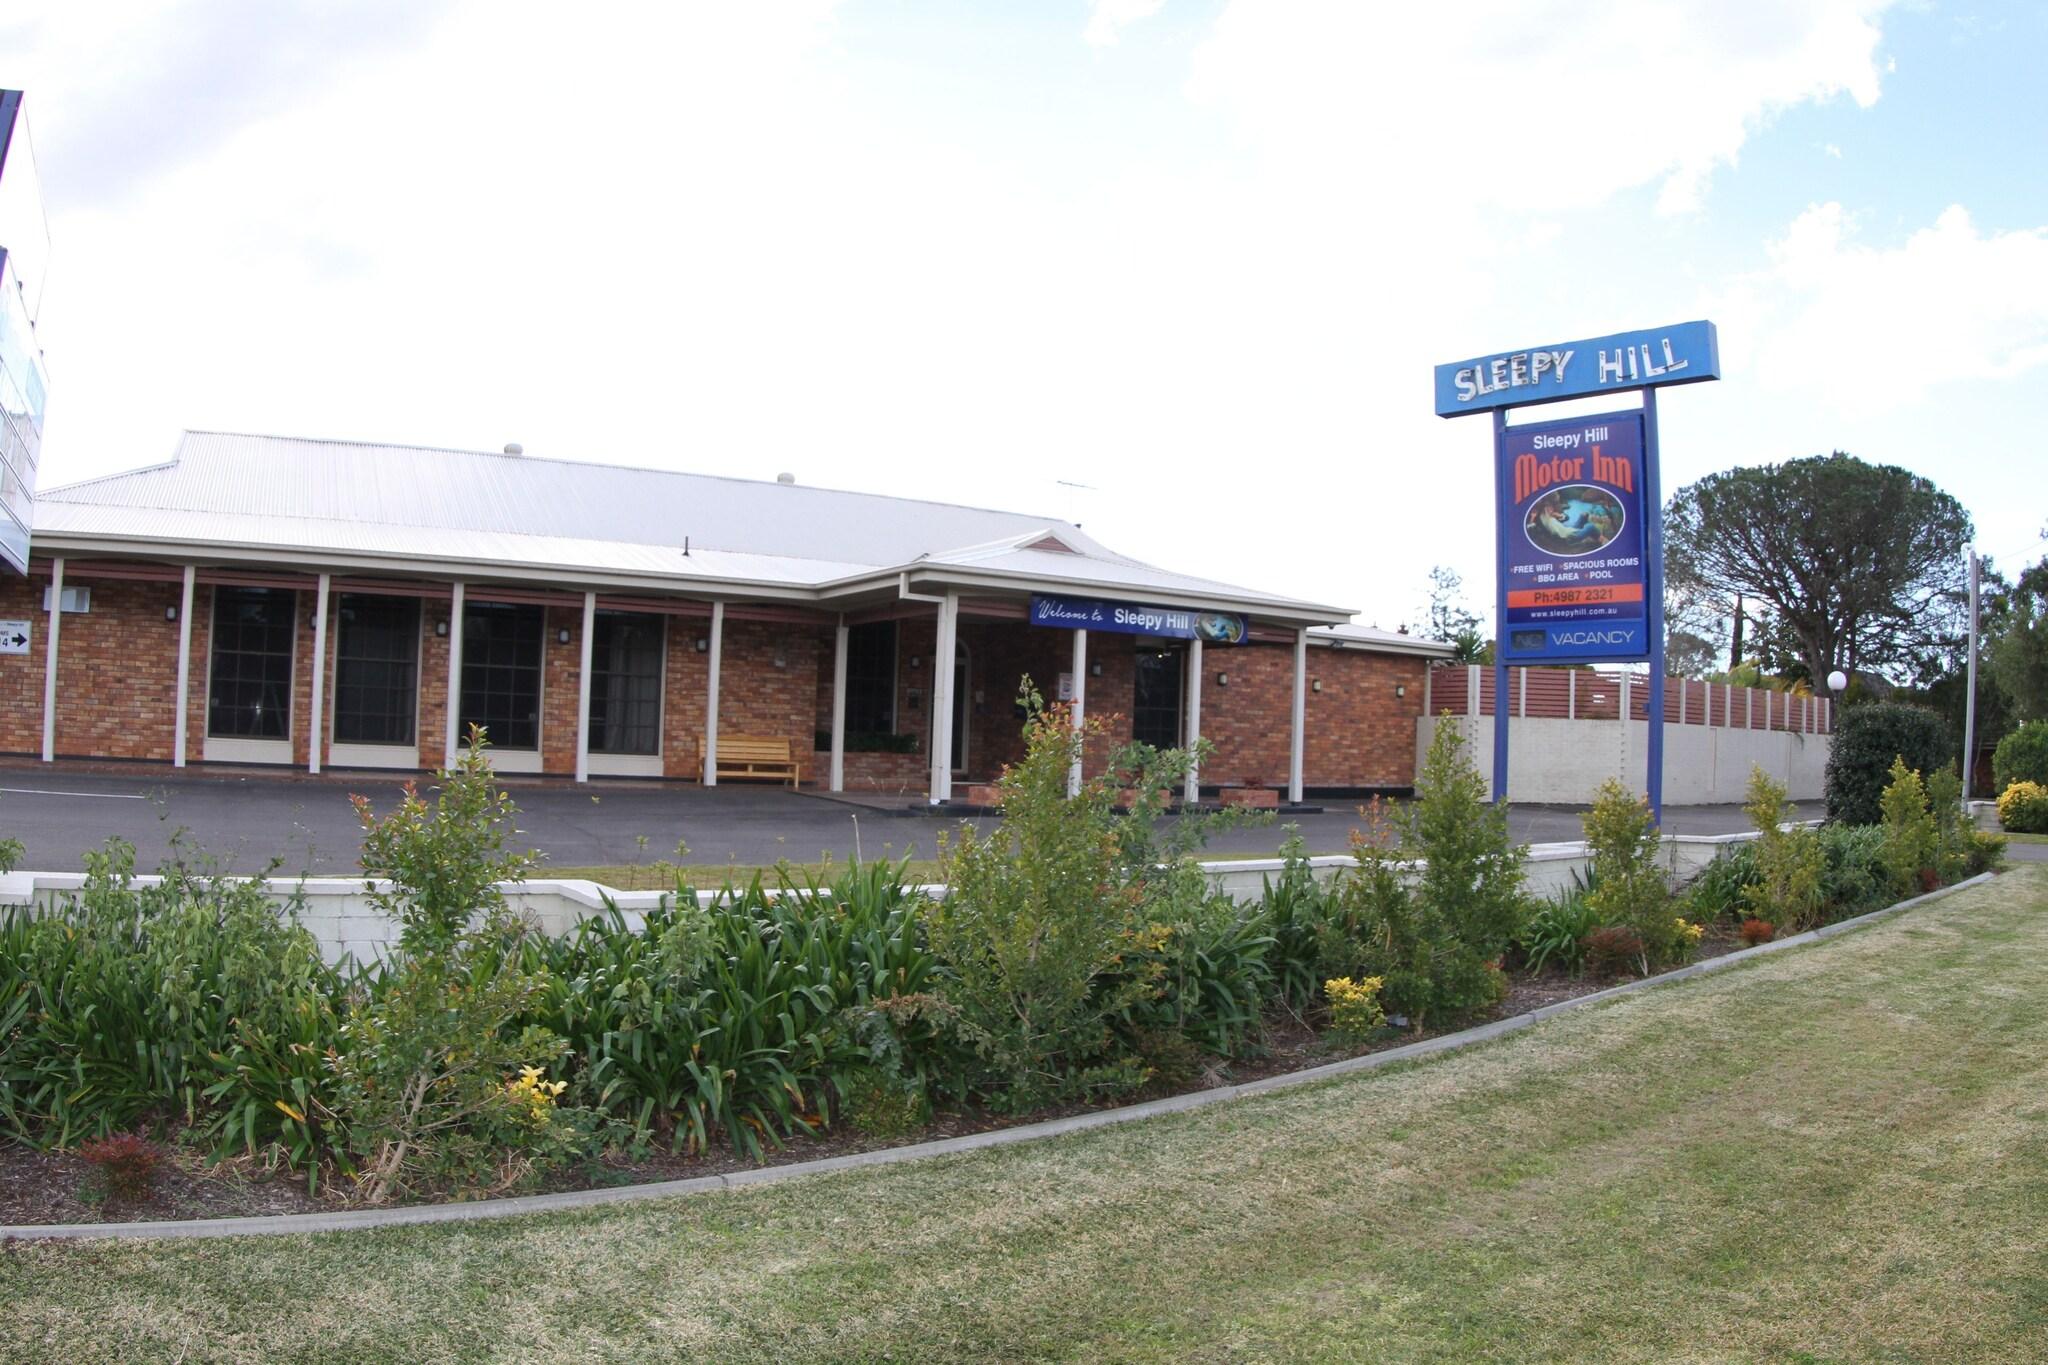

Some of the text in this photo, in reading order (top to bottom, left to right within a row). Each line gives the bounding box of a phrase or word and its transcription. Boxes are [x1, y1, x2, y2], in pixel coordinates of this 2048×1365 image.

[1455, 338, 1689, 402] SLEEPY HILL
[1533, 427, 1608, 449] Sleepy Hill
[1515, 445, 1633, 505] Motor Inn
[1513, 557, 1639, 573] FREE WIFI SPACIOUS ROOMS
[1537, 571, 1613, 583] BBQ AREA POOL
[1534, 589, 1613, 603] Ph:4987 2321
[1038, 600, 1189, 631] Welcome to Sleepy Hill
[1531, 608, 1618, 618] www.sleepyhill.com.au
[1552, 630, 1634, 645] VACANCY
